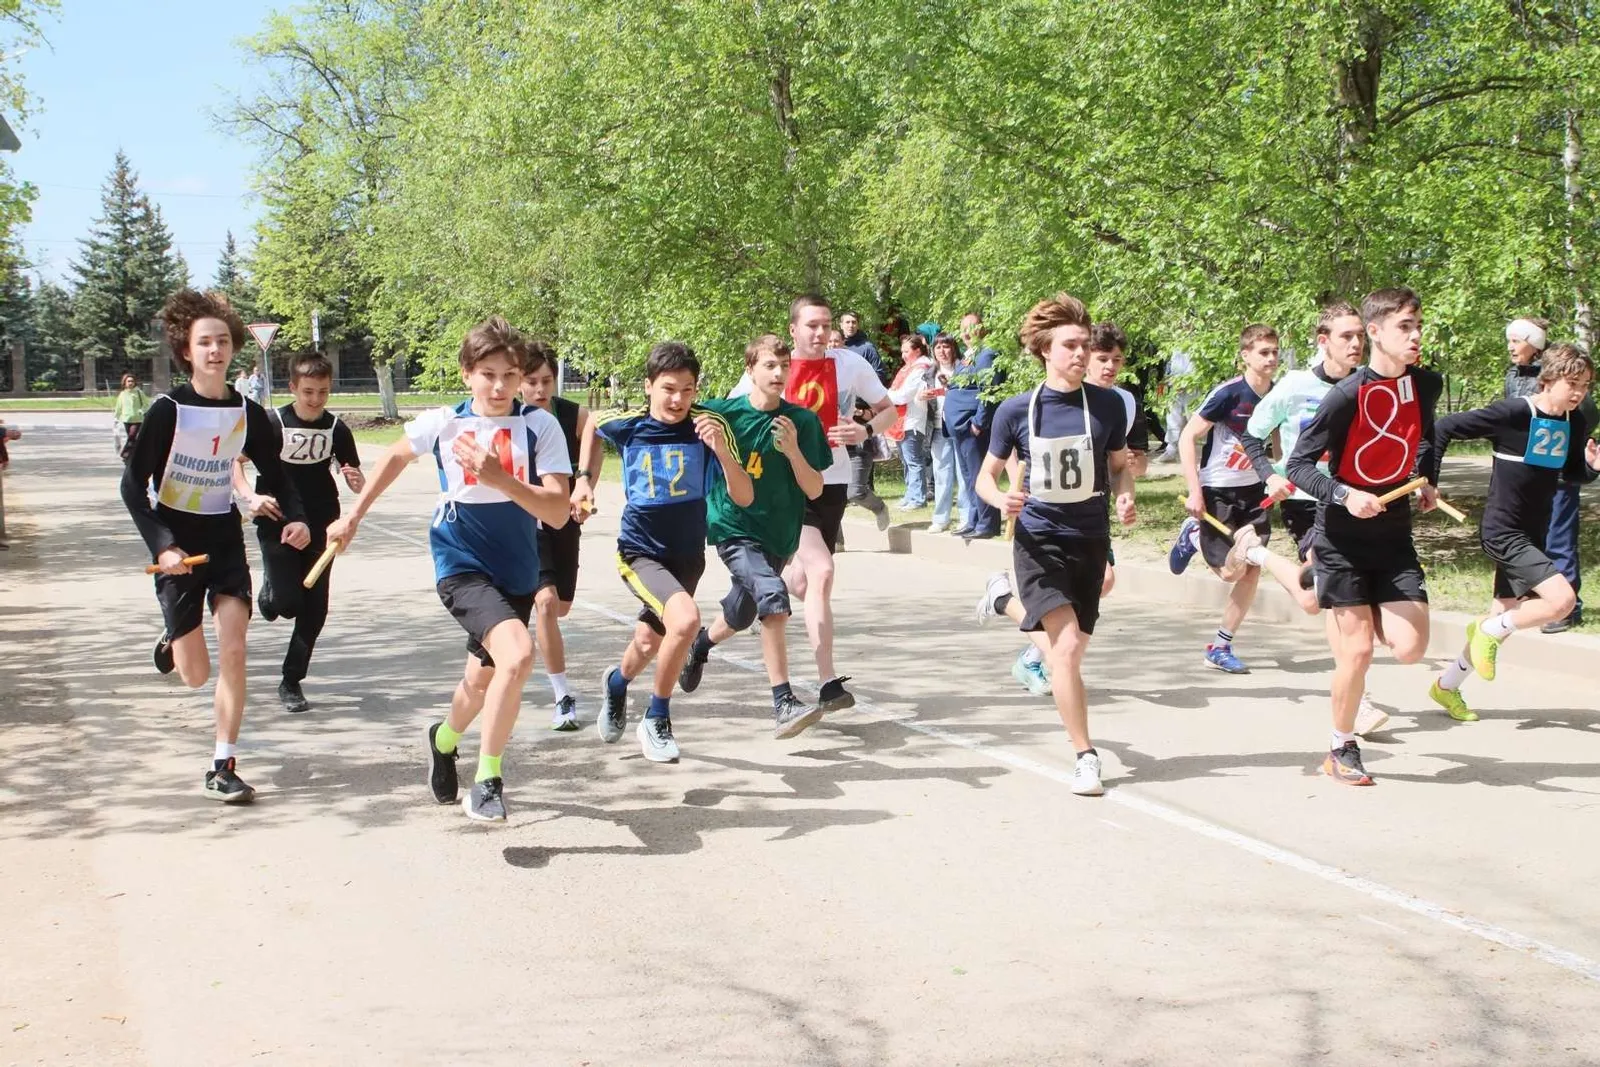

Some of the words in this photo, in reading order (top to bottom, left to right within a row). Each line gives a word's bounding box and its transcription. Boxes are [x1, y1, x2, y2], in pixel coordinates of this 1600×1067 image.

[211, 435, 221, 456] 1
[289, 433, 327, 460] 20
[1354, 385, 1409, 484] 8
[1532, 428, 1567, 457] 22
[641, 450, 688, 499] 12
[745, 451, 764, 479] 4
[1042, 448, 1082, 490] 18
